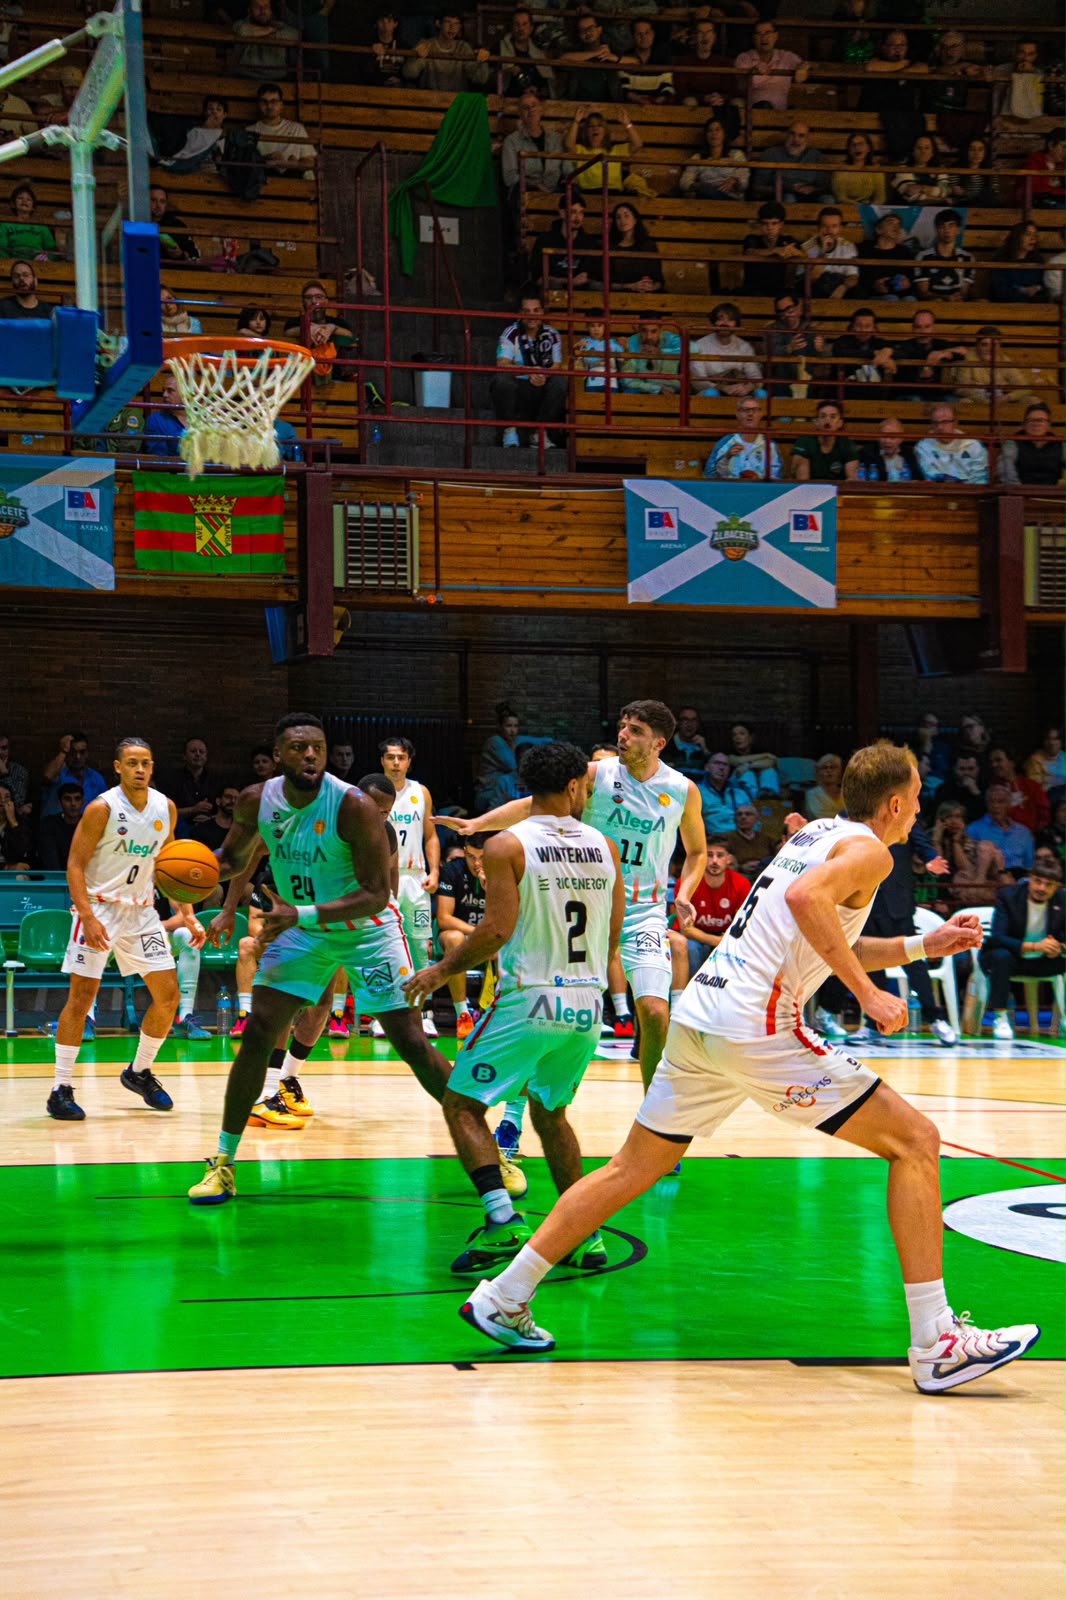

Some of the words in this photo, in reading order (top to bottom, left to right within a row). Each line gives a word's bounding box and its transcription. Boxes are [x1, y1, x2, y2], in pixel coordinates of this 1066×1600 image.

[68, 490, 97, 510] BA
[0, 505, 26, 519] CETE
[648, 511, 675, 528] BA
[793, 514, 819, 531] BA
[224, 523, 232, 547] MARIA
[606, 807, 666, 835] AlegA
[399, 829, 407, 847] 7
[535, 846, 603, 863] WINTERING
[620, 838, 644, 867] 11
[126, 864, 139, 885] 0
[571, 877, 608, 890] ENERGY
[290, 874, 316, 903] 24
[461, 893, 486, 909] Aleg
[729, 874, 774, 939] 5
[565, 900, 588, 964] 2
